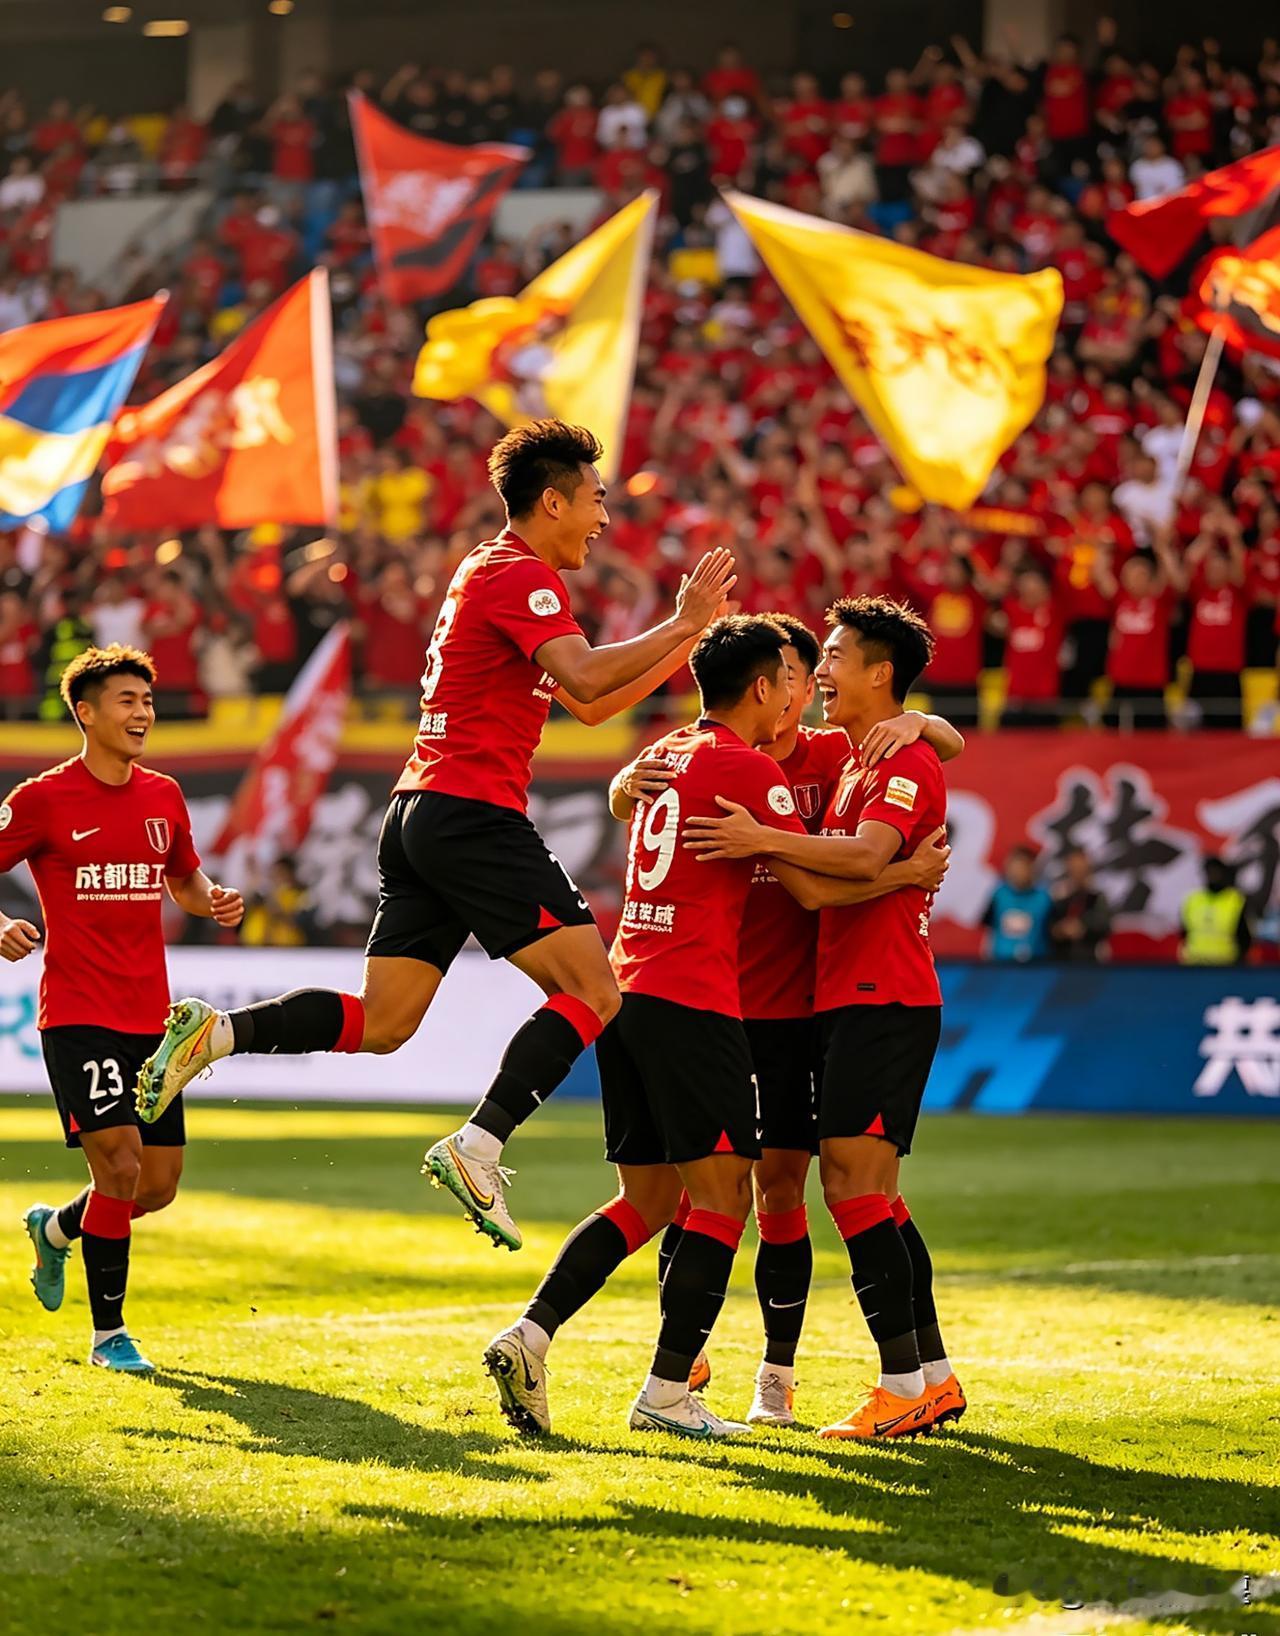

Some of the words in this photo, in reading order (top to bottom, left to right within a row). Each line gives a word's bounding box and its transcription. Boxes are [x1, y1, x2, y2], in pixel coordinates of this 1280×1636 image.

[626, 787, 680, 891] 19
[75, 863, 165, 890] 成都建工
[83, 1058, 123, 1100] 23
